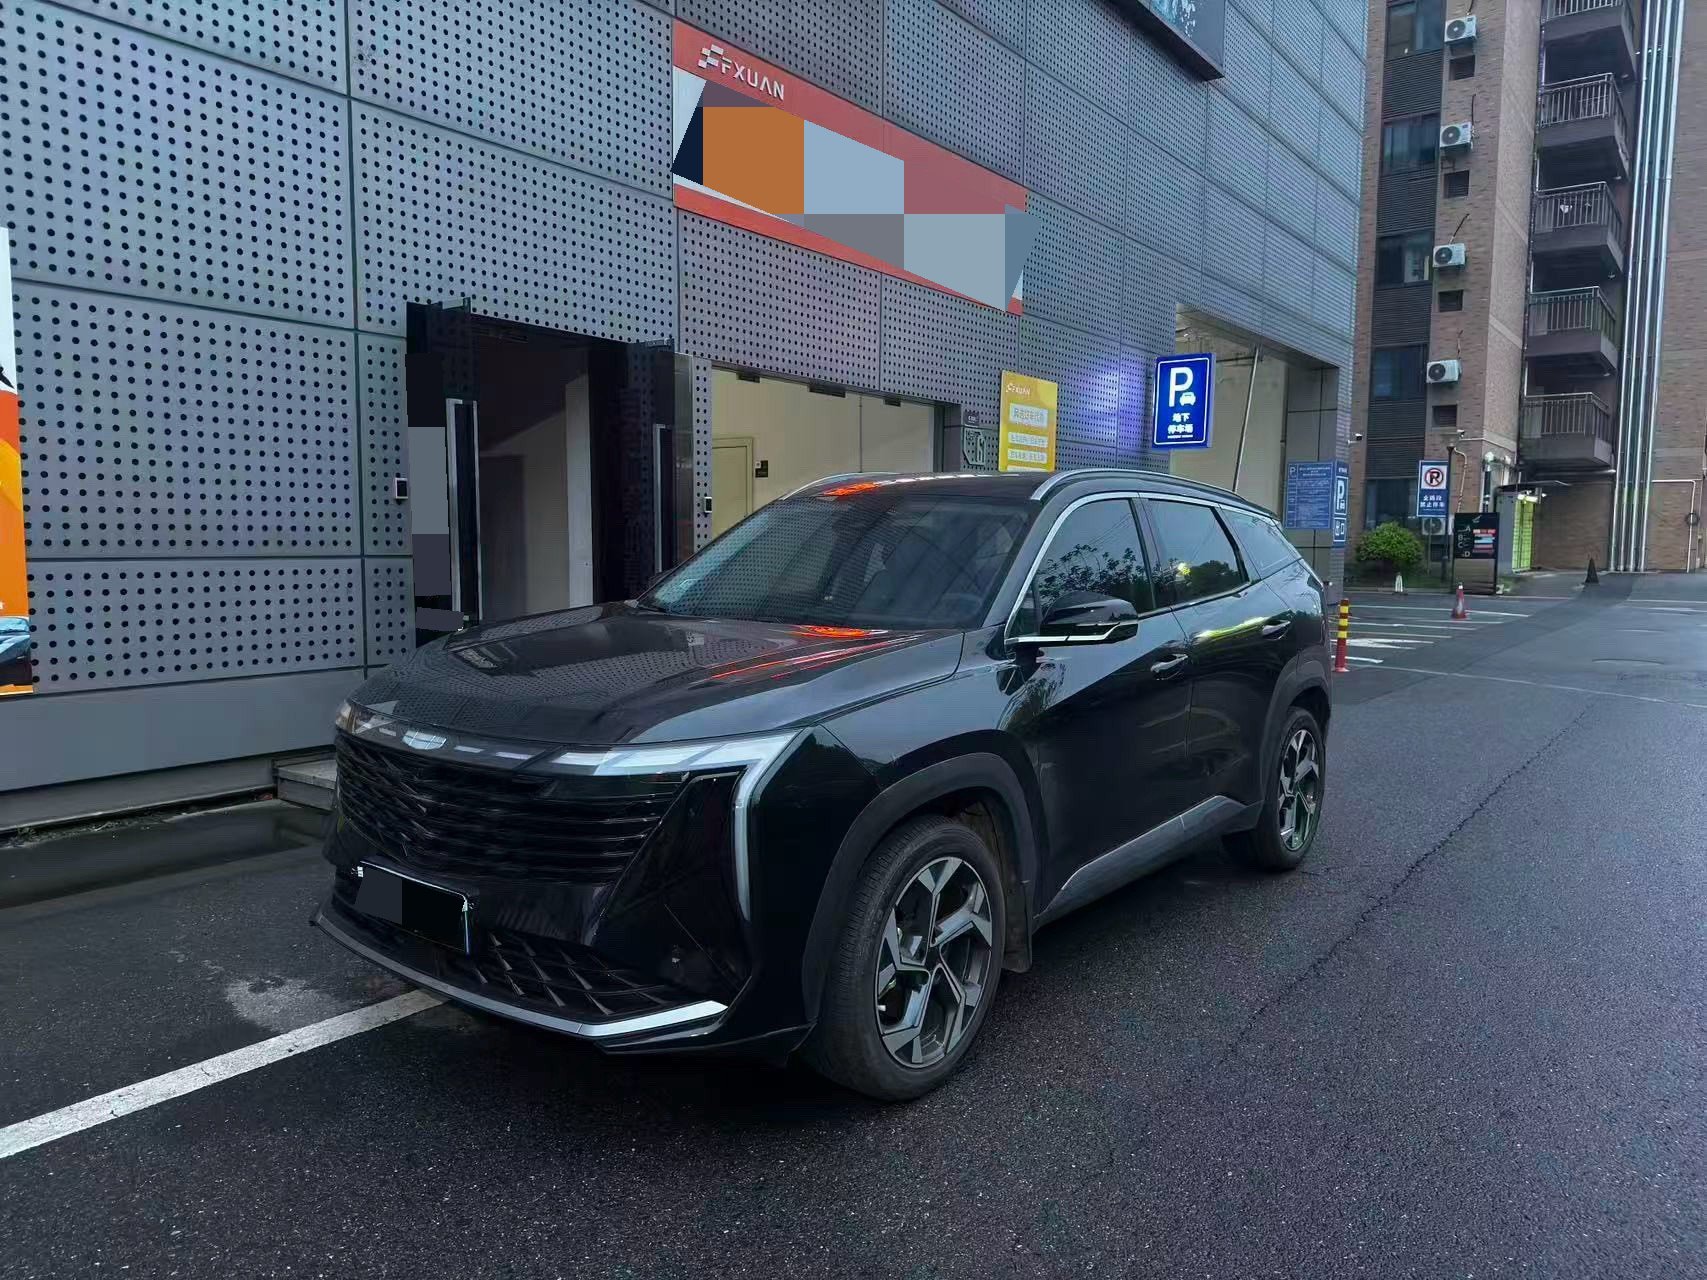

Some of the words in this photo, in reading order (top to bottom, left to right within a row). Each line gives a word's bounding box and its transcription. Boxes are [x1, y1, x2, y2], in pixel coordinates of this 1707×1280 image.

[721, 57, 784, 100] FXUAN
[1168, 366, 1194, 408] P
[1336, 480, 1345, 510] P
